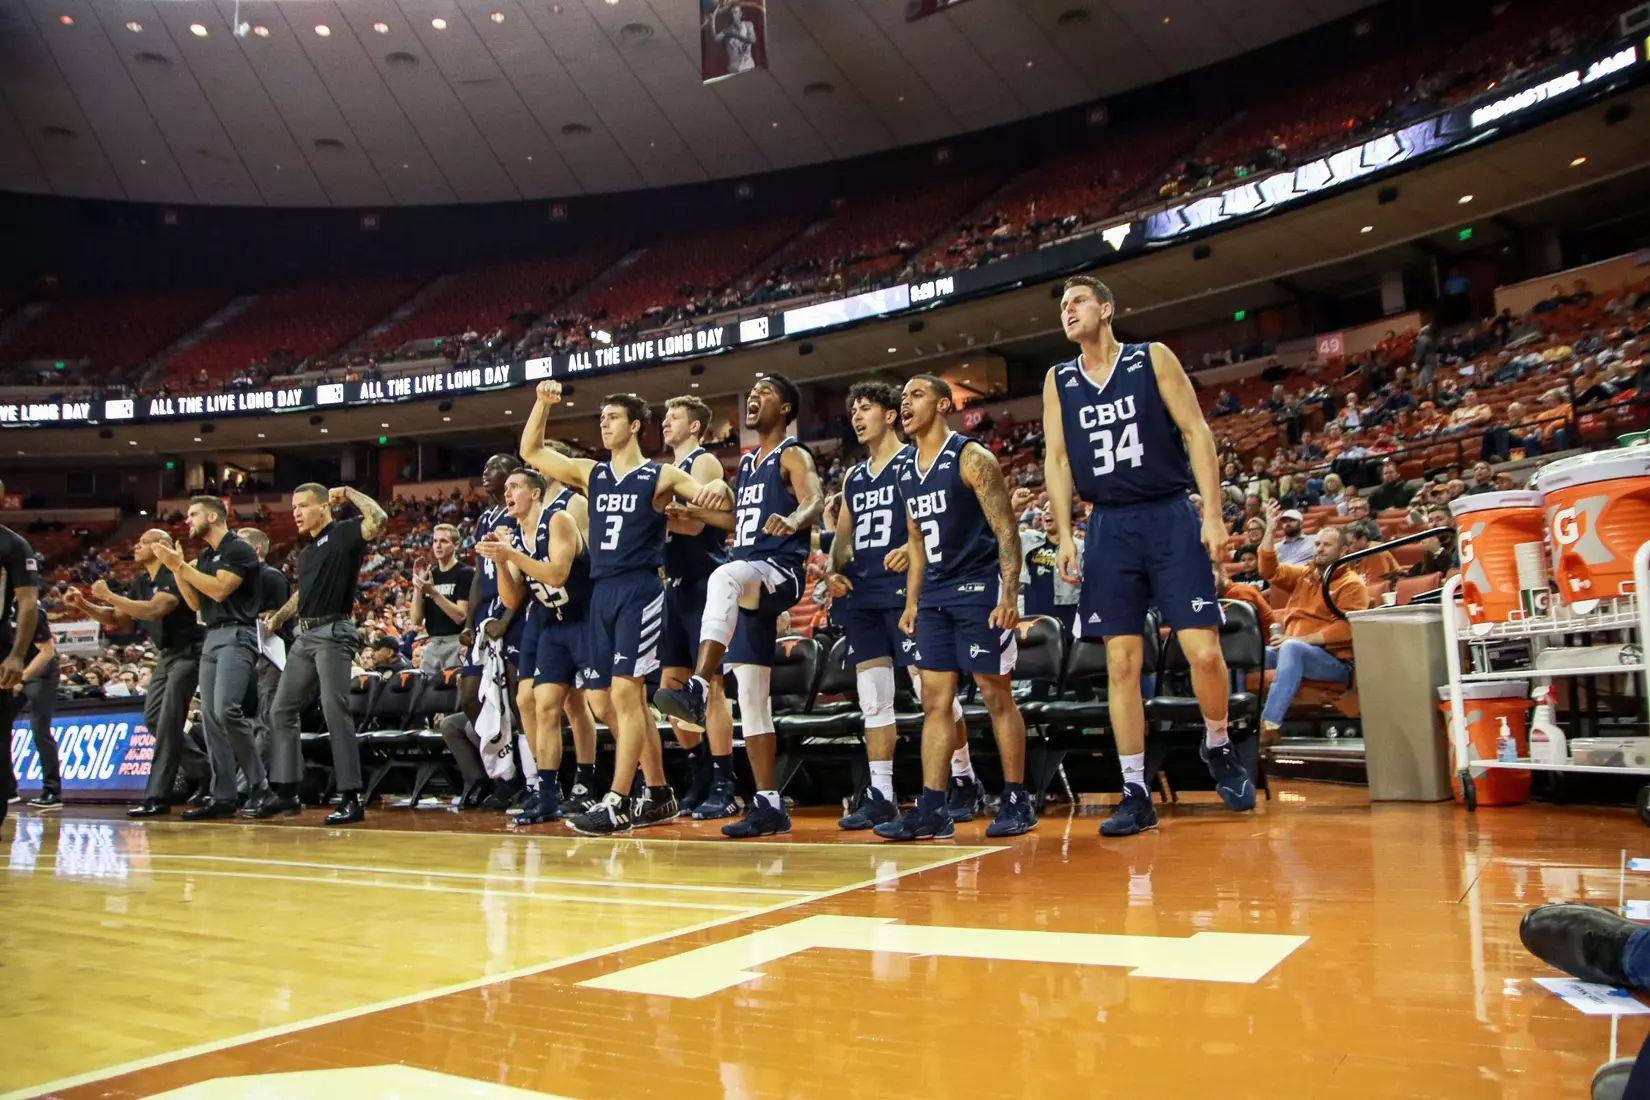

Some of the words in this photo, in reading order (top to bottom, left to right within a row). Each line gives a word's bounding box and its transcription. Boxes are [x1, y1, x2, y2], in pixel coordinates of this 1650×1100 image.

[1471, 70, 1581, 128] MONSTER
[1582, 45, 1637, 83] JAM
[936, 276, 954, 296] PM
[568, 352, 592, 372] ALL
[595, 346, 620, 367] THE
[624, 341, 653, 362] LIVE
[658, 333, 693, 356] LONG
[697, 327, 723, 349] DAY
[1320, 338, 1339, 354] 49
[1126, 361, 1143, 373] WAC
[360, 381, 384, 399] ALL
[387, 378, 411, 396] THE
[415, 374, 442, 393] LIVE
[447, 369, 480, 389] LONG
[485, 365, 509, 384] DAY
[0, 405, 18, 421] VE
[21, 404, 59, 421] LONG
[62, 403, 90, 420] DAY
[150, 398, 174, 415] ALL
[178, 396, 203, 413] THE
[206, 394, 235, 412] LIVE
[239, 392, 273, 409] LONG
[277, 389, 302, 407] DAY
[1079, 395, 1136, 429] CBU
[1089, 422, 1144, 477] 34
[596, 493, 638, 513] CBU
[736, 483, 765, 507] CBU
[852, 484, 895, 513] CBU
[906, 489, 947, 520] CBU
[600, 515, 624, 551] 3
[733, 507, 761, 548] 32
[855, 509, 893, 551] 23
[1554, 507, 1579, 545] G
[920, 519, 942, 563] 2
[1458, 530, 1474, 564] G
[1535, 592, 1549, 610] G
[124, 747, 154, 761] WARR
[129, 734, 157, 747] WOUN
[498, 741, 514, 759] GA
[117, 762, 152, 776] PROJE
